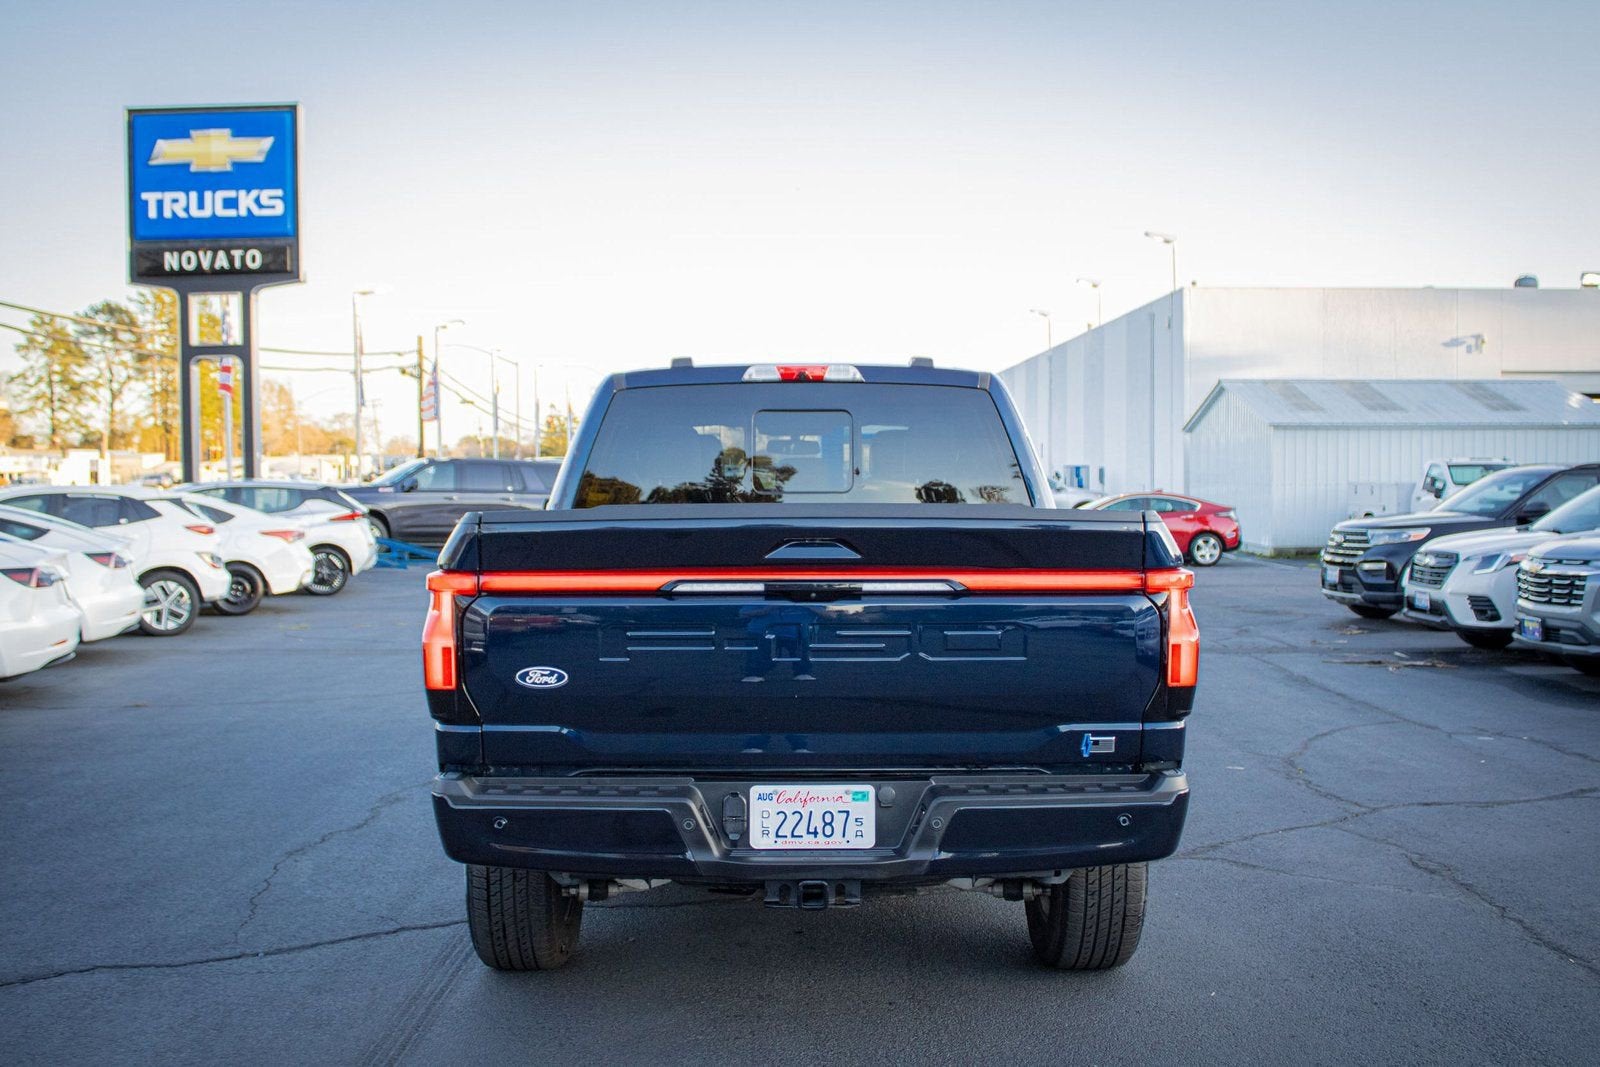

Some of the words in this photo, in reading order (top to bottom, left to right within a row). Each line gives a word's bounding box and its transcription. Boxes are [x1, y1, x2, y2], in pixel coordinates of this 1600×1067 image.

[140, 188, 285, 220] TRUCKS
[163, 248, 263, 272] NOVATO
[525, 669, 559, 684] Ford
[757, 792, 773, 801] AUG
[776, 790, 851, 808] California
[775, 810, 851, 839] 22487
